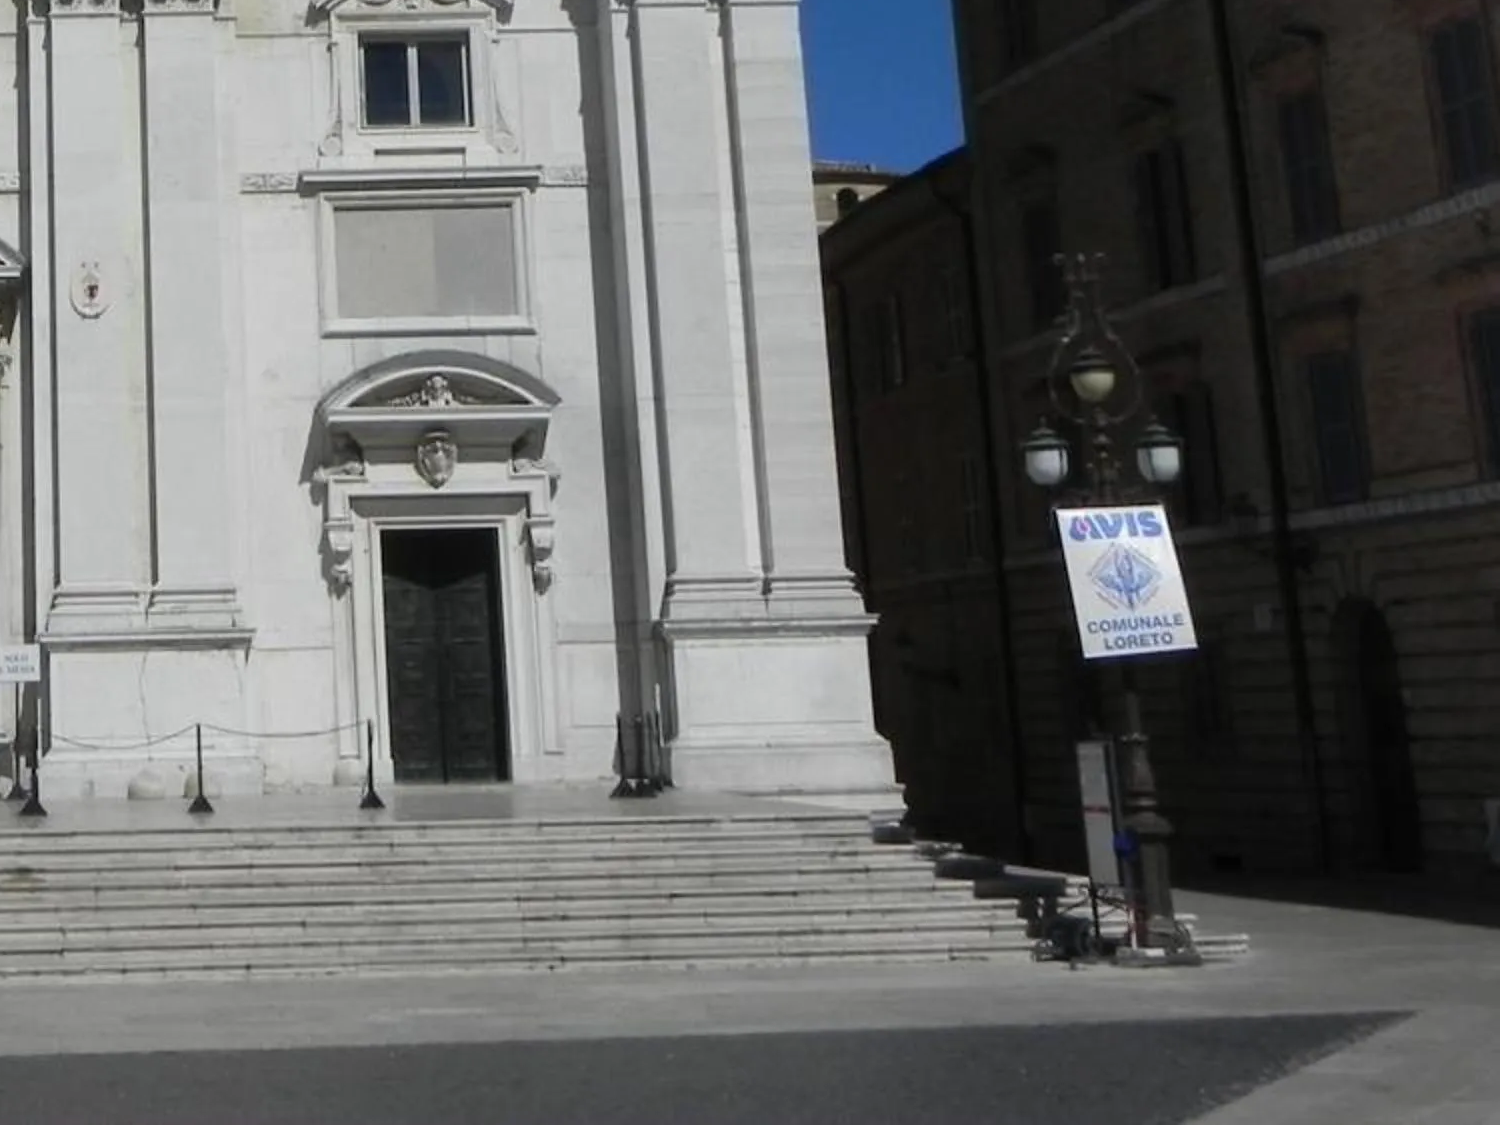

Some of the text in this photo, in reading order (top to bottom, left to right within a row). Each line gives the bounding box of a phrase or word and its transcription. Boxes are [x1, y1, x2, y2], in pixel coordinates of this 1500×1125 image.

[1069, 511, 1164, 542] AVIS
[1087, 613, 1185, 635] COMUNALE
[1103, 632, 1173, 651] LORETO
